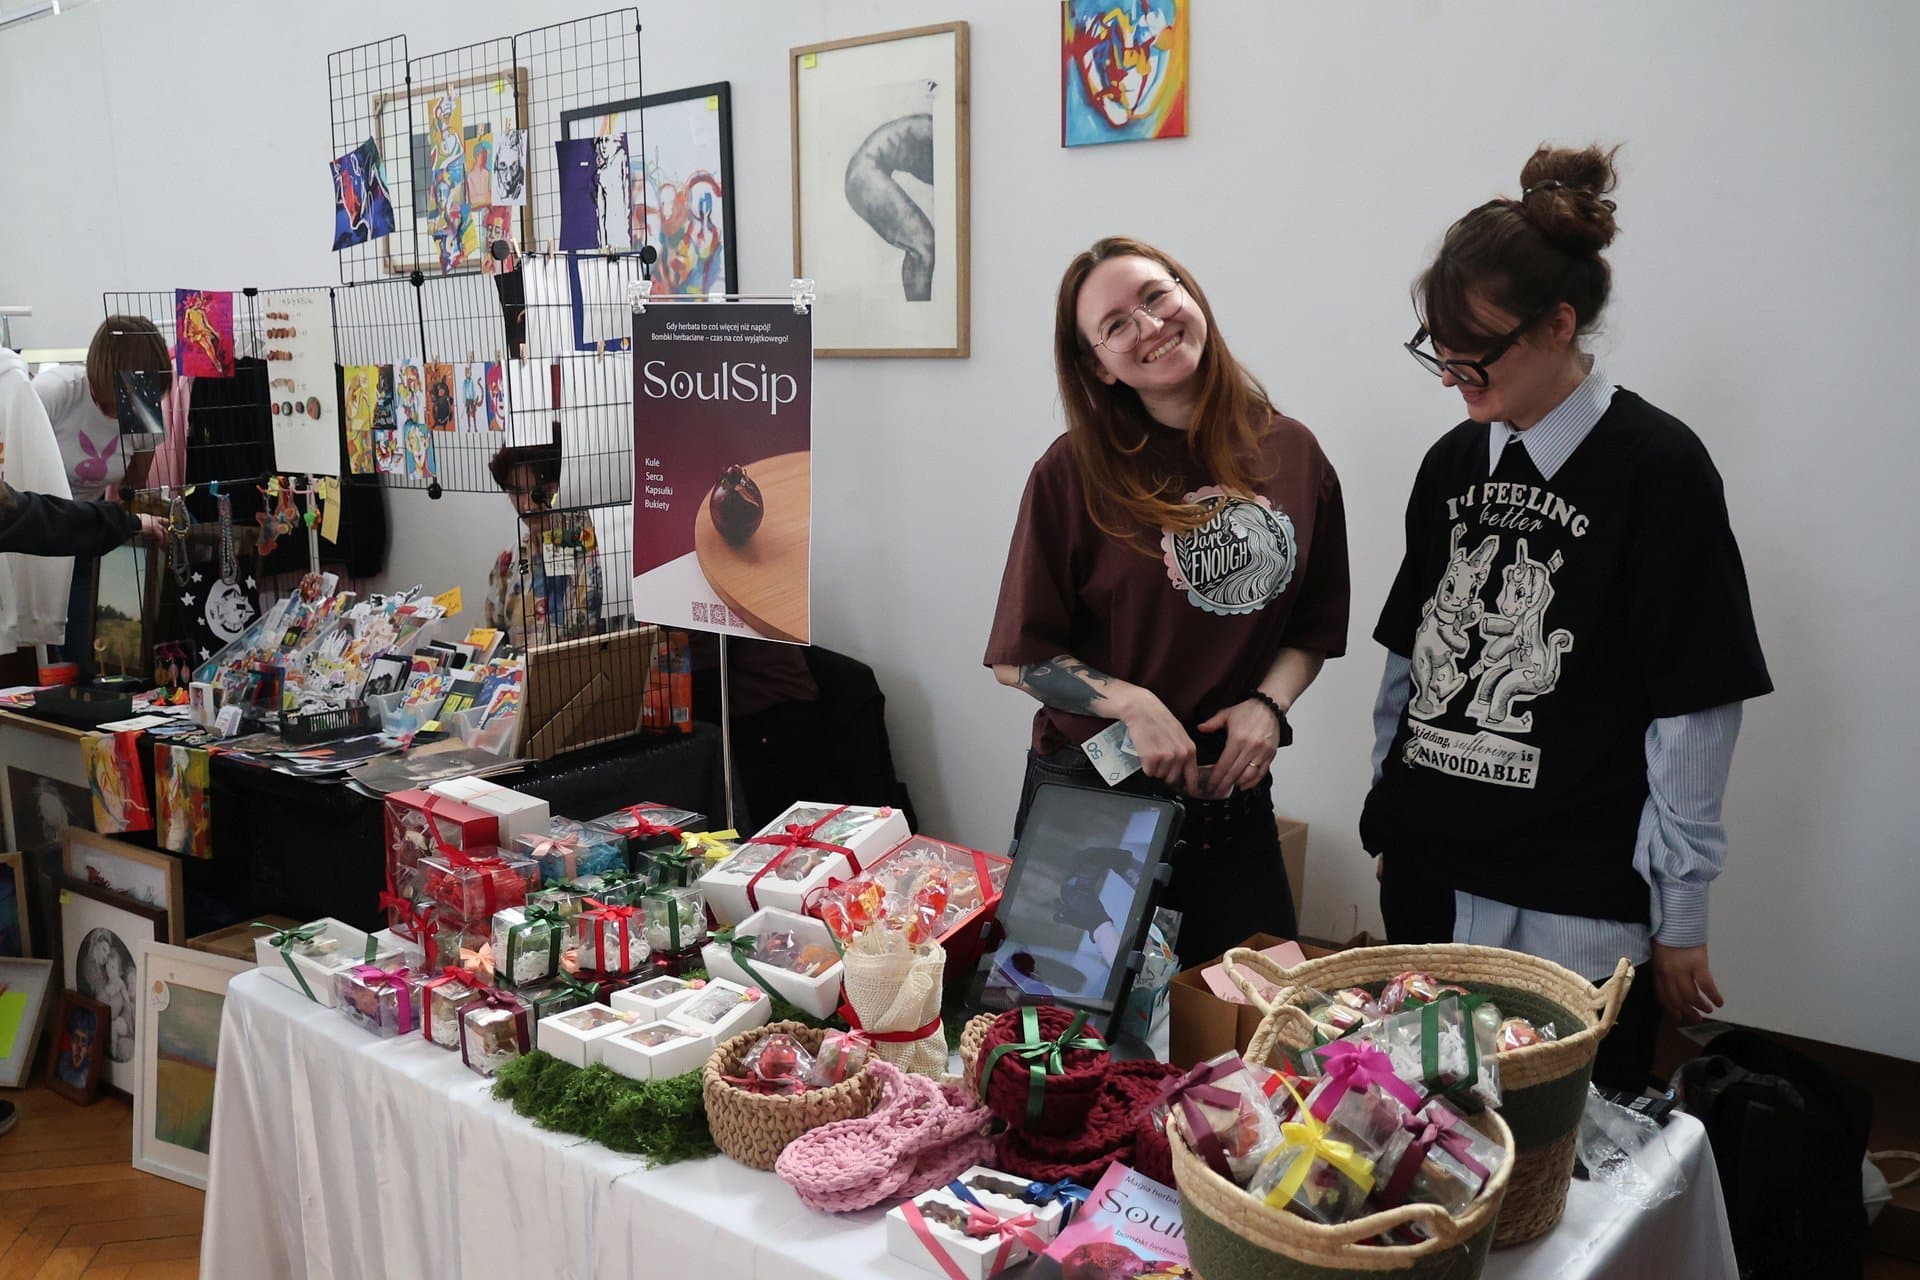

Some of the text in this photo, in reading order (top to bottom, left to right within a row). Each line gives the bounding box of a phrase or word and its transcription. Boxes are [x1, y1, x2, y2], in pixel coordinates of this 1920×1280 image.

[665, 321, 677, 331] Gdy
[678, 321, 700, 330] herbata
[708, 322, 719, 330] coś
[720, 322, 739, 332] więcej
[740, 322, 750, 331] niż
[751, 322, 771, 333] napój!
[651, 332, 672, 341] Bombki
[673, 333, 704, 341] herbaciane
[733, 334, 743, 342] coś
[744, 334, 789, 344] wyjątkowego!
[643, 360, 798, 416] SoulSip
[645, 457, 660, 467] Kule
[645, 471, 664, 482] Serca
[645, 485, 674, 496] Kapsułki
[645, 499, 670, 511] Bukiety
[1481, 482, 1590, 537] FEELING
[1479, 503, 1544, 532] better
[1198, 530, 1233, 547] are
[1191, 541, 1248, 586] ENOUGH
[1086, 742, 1104, 760] 50
[1452, 733, 1518, 764] suffering
[1520, 750, 1534, 762] is
[1412, 744, 1532, 785] NAVOIDABLE
[1151, 1188, 1181, 1206] herbat
[1098, 1188, 1185, 1239] Soul
